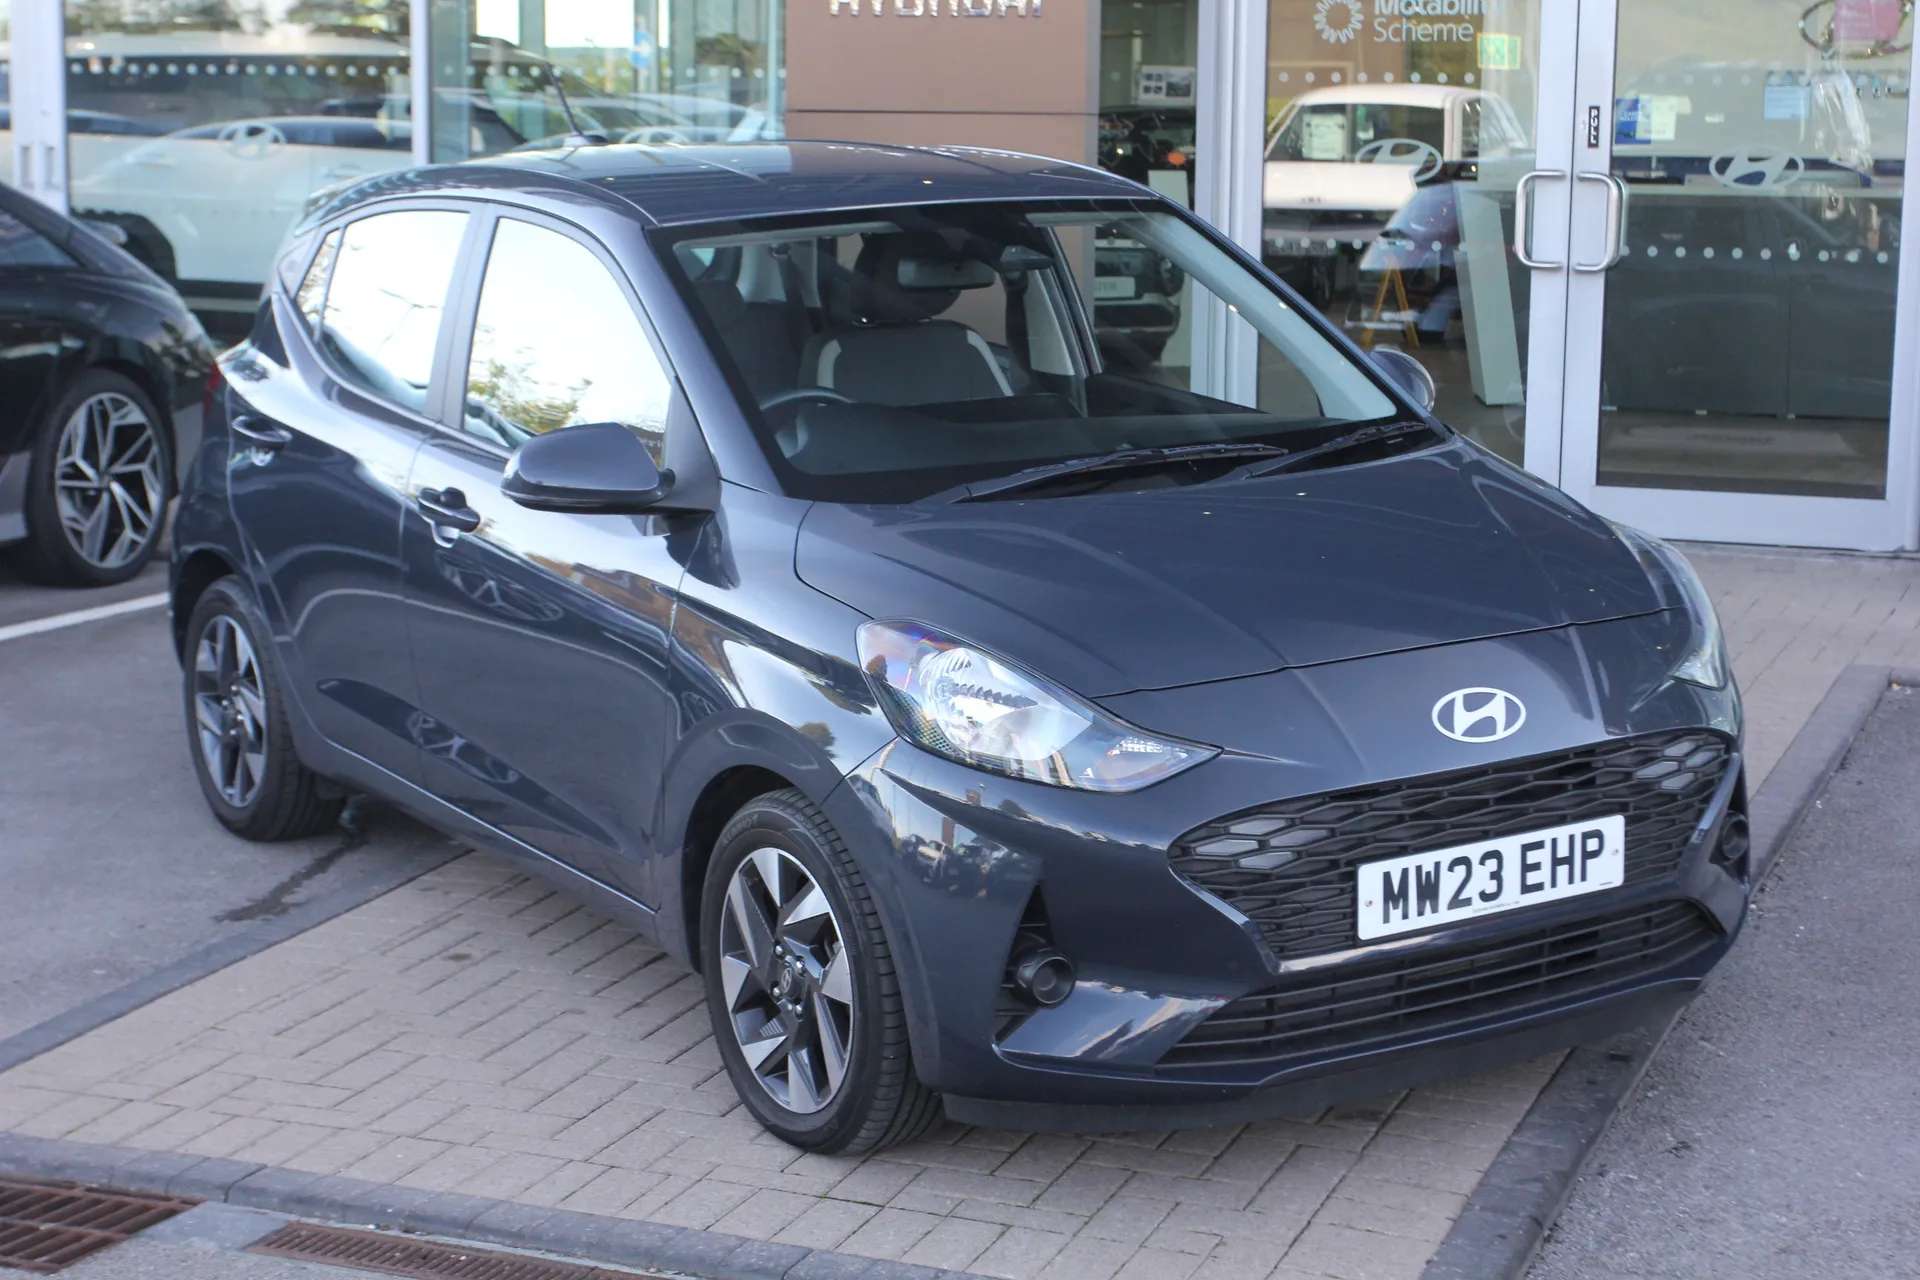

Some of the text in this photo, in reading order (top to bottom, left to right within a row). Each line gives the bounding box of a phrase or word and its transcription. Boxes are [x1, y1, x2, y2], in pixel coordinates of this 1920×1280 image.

[1373, 17, 1474, 42] Scheme
[1590, 108, 1599, 144] PULL
[1382, 828, 1605, 924] MW23 EHP
